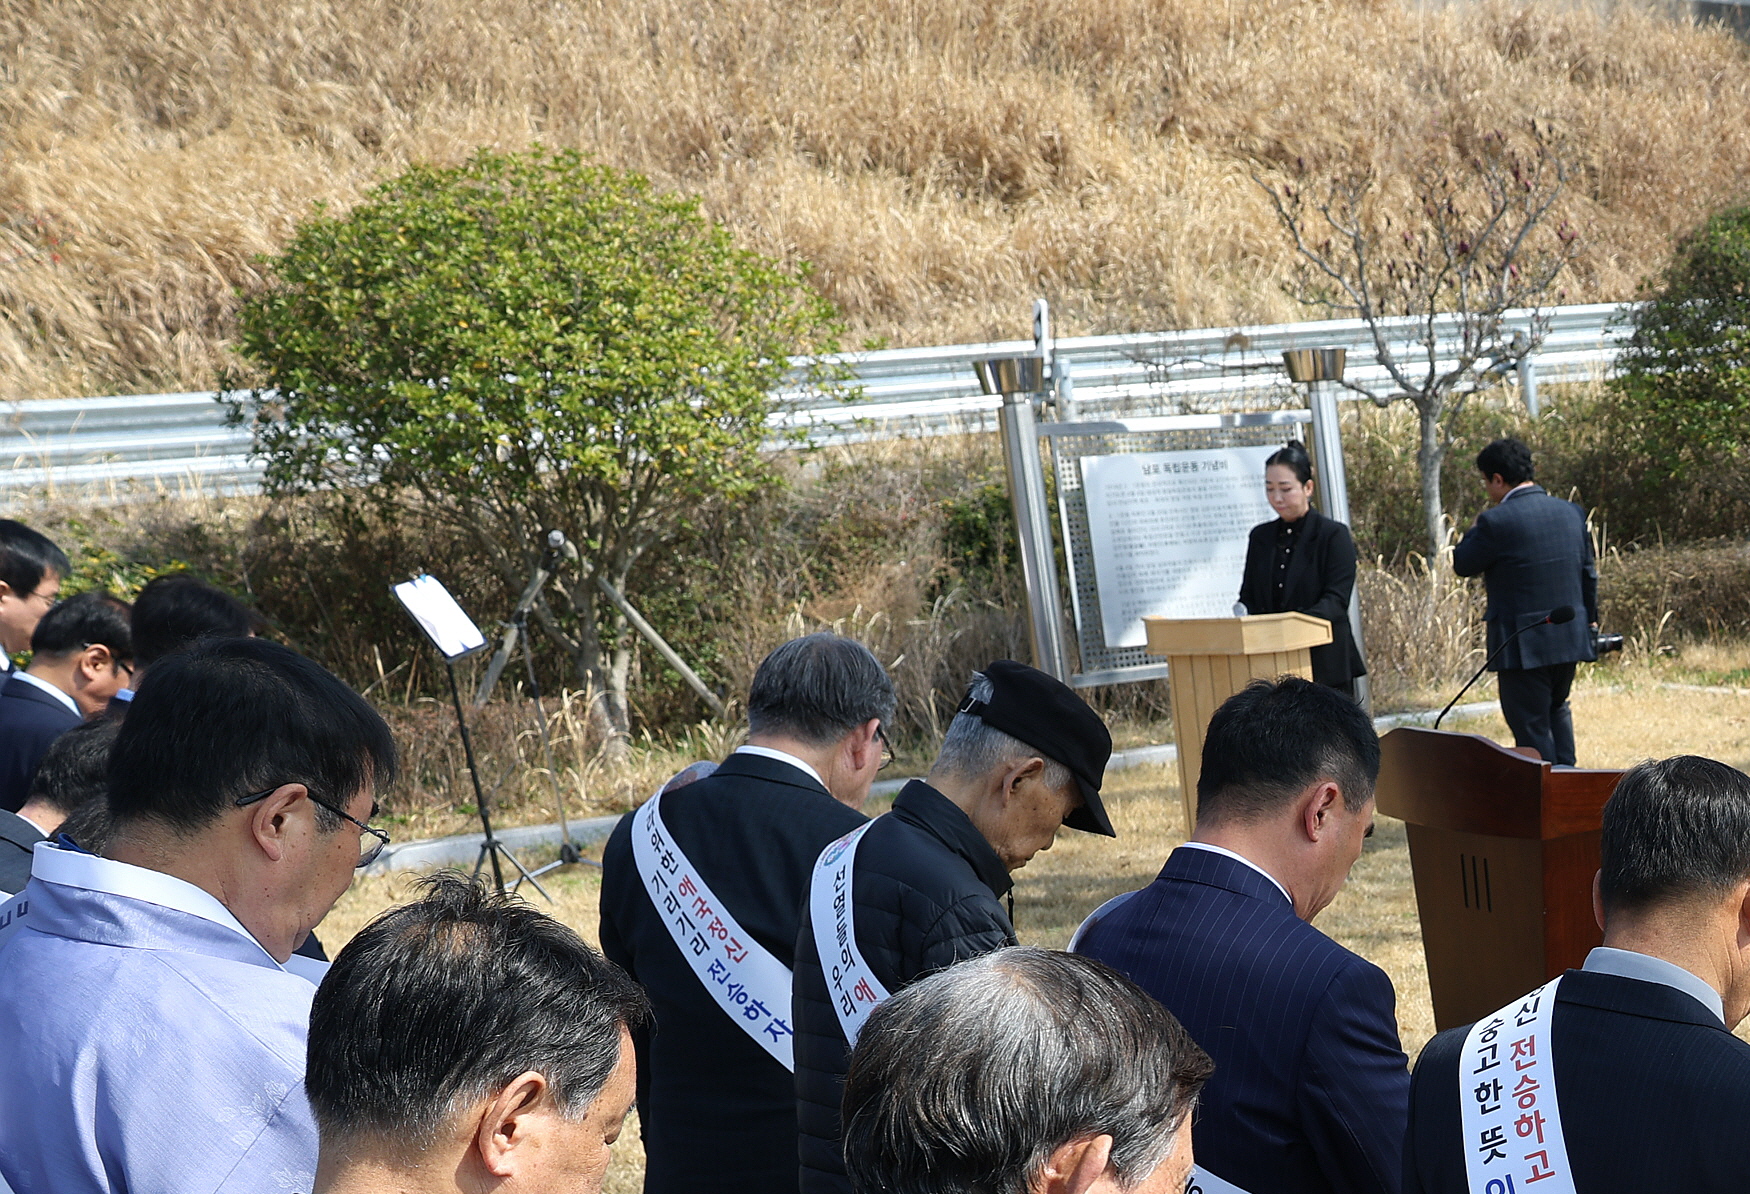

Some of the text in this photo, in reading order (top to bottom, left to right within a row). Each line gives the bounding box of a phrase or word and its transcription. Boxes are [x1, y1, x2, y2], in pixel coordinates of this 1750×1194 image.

[651, 870, 794, 1043] 기리기리 전승하자
[678, 874, 748, 964] 애국정신
[833, 864, 856, 972] 선열들의
[832, 965, 857, 1017] 우리
[1473, 1018, 1505, 1116] 숭고한
[1509, 1034, 1556, 1184] 전승하고
[1478, 1124, 1508, 1164] 뜻
